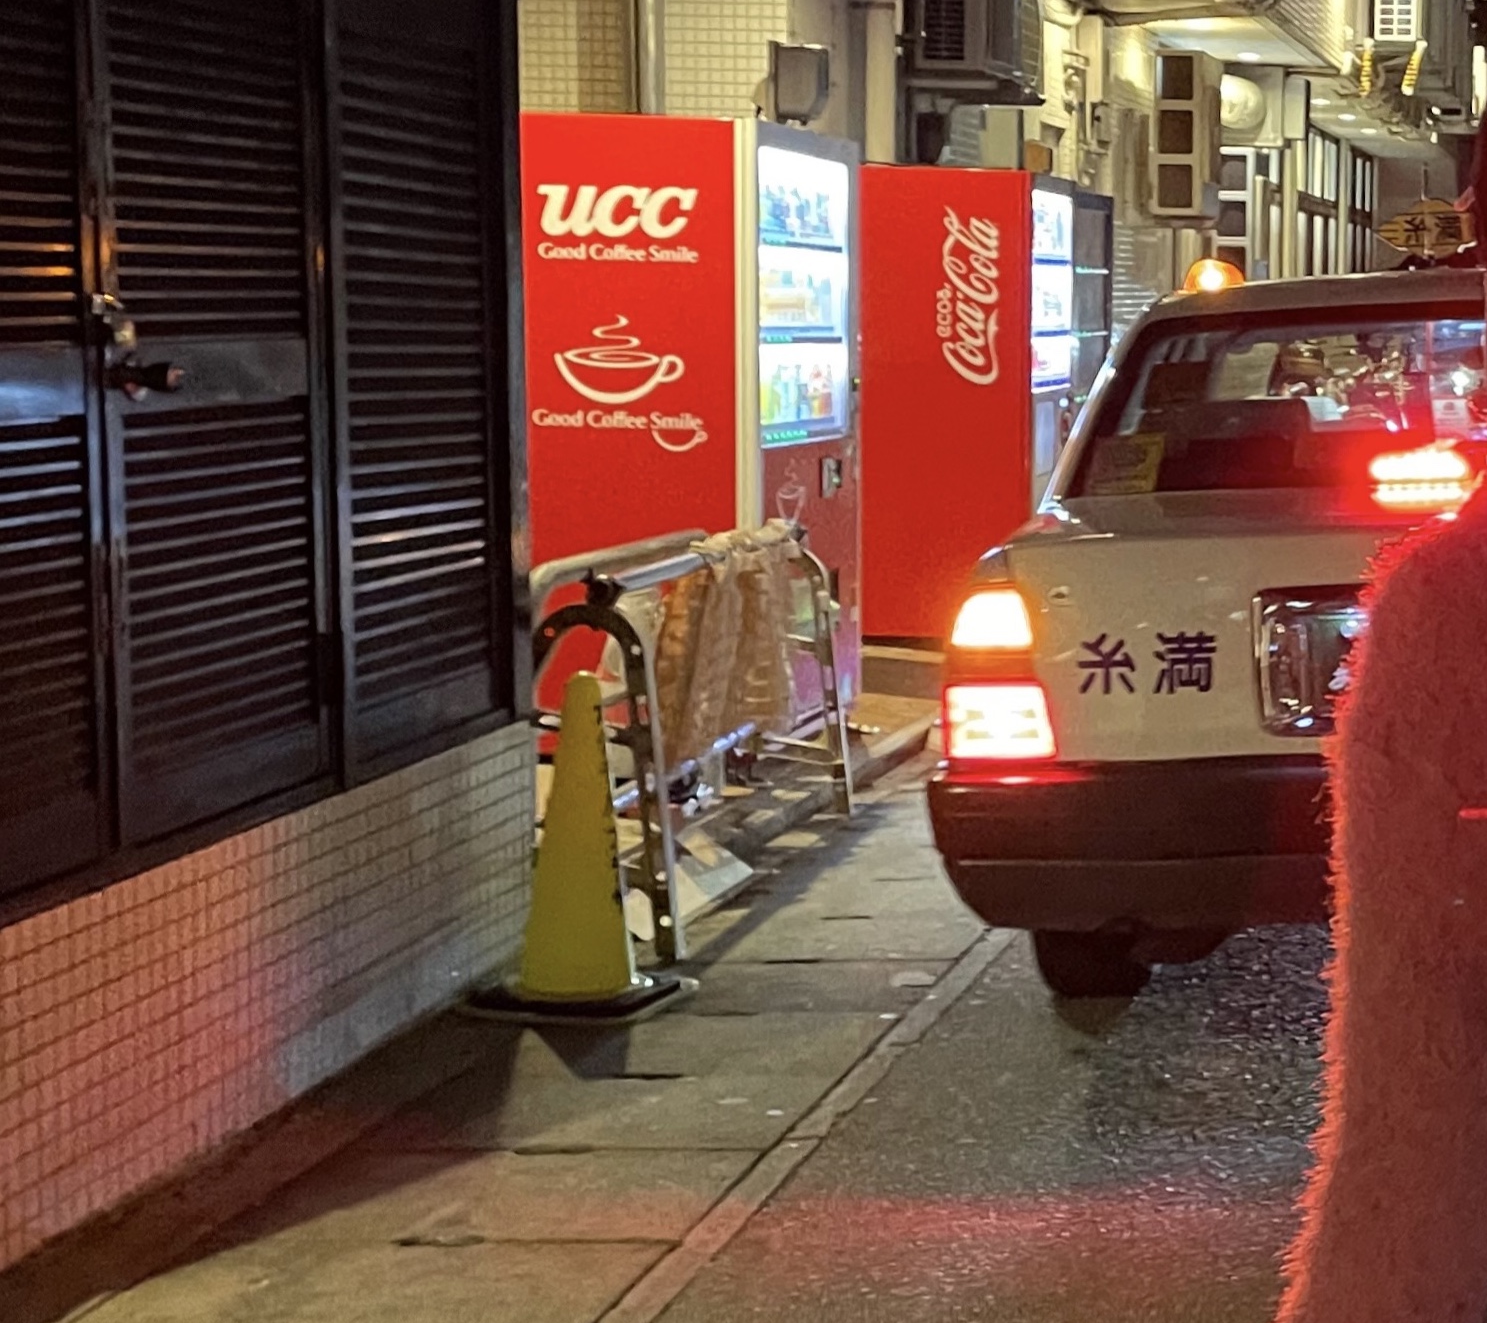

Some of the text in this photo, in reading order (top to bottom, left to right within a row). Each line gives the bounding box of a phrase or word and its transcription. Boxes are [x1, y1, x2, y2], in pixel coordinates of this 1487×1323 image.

[536, 242, 699, 263] Good Coffee Smile
[531, 409, 704, 430] Good Coffee Smile
[1077, 631, 1217, 695] 糸満
